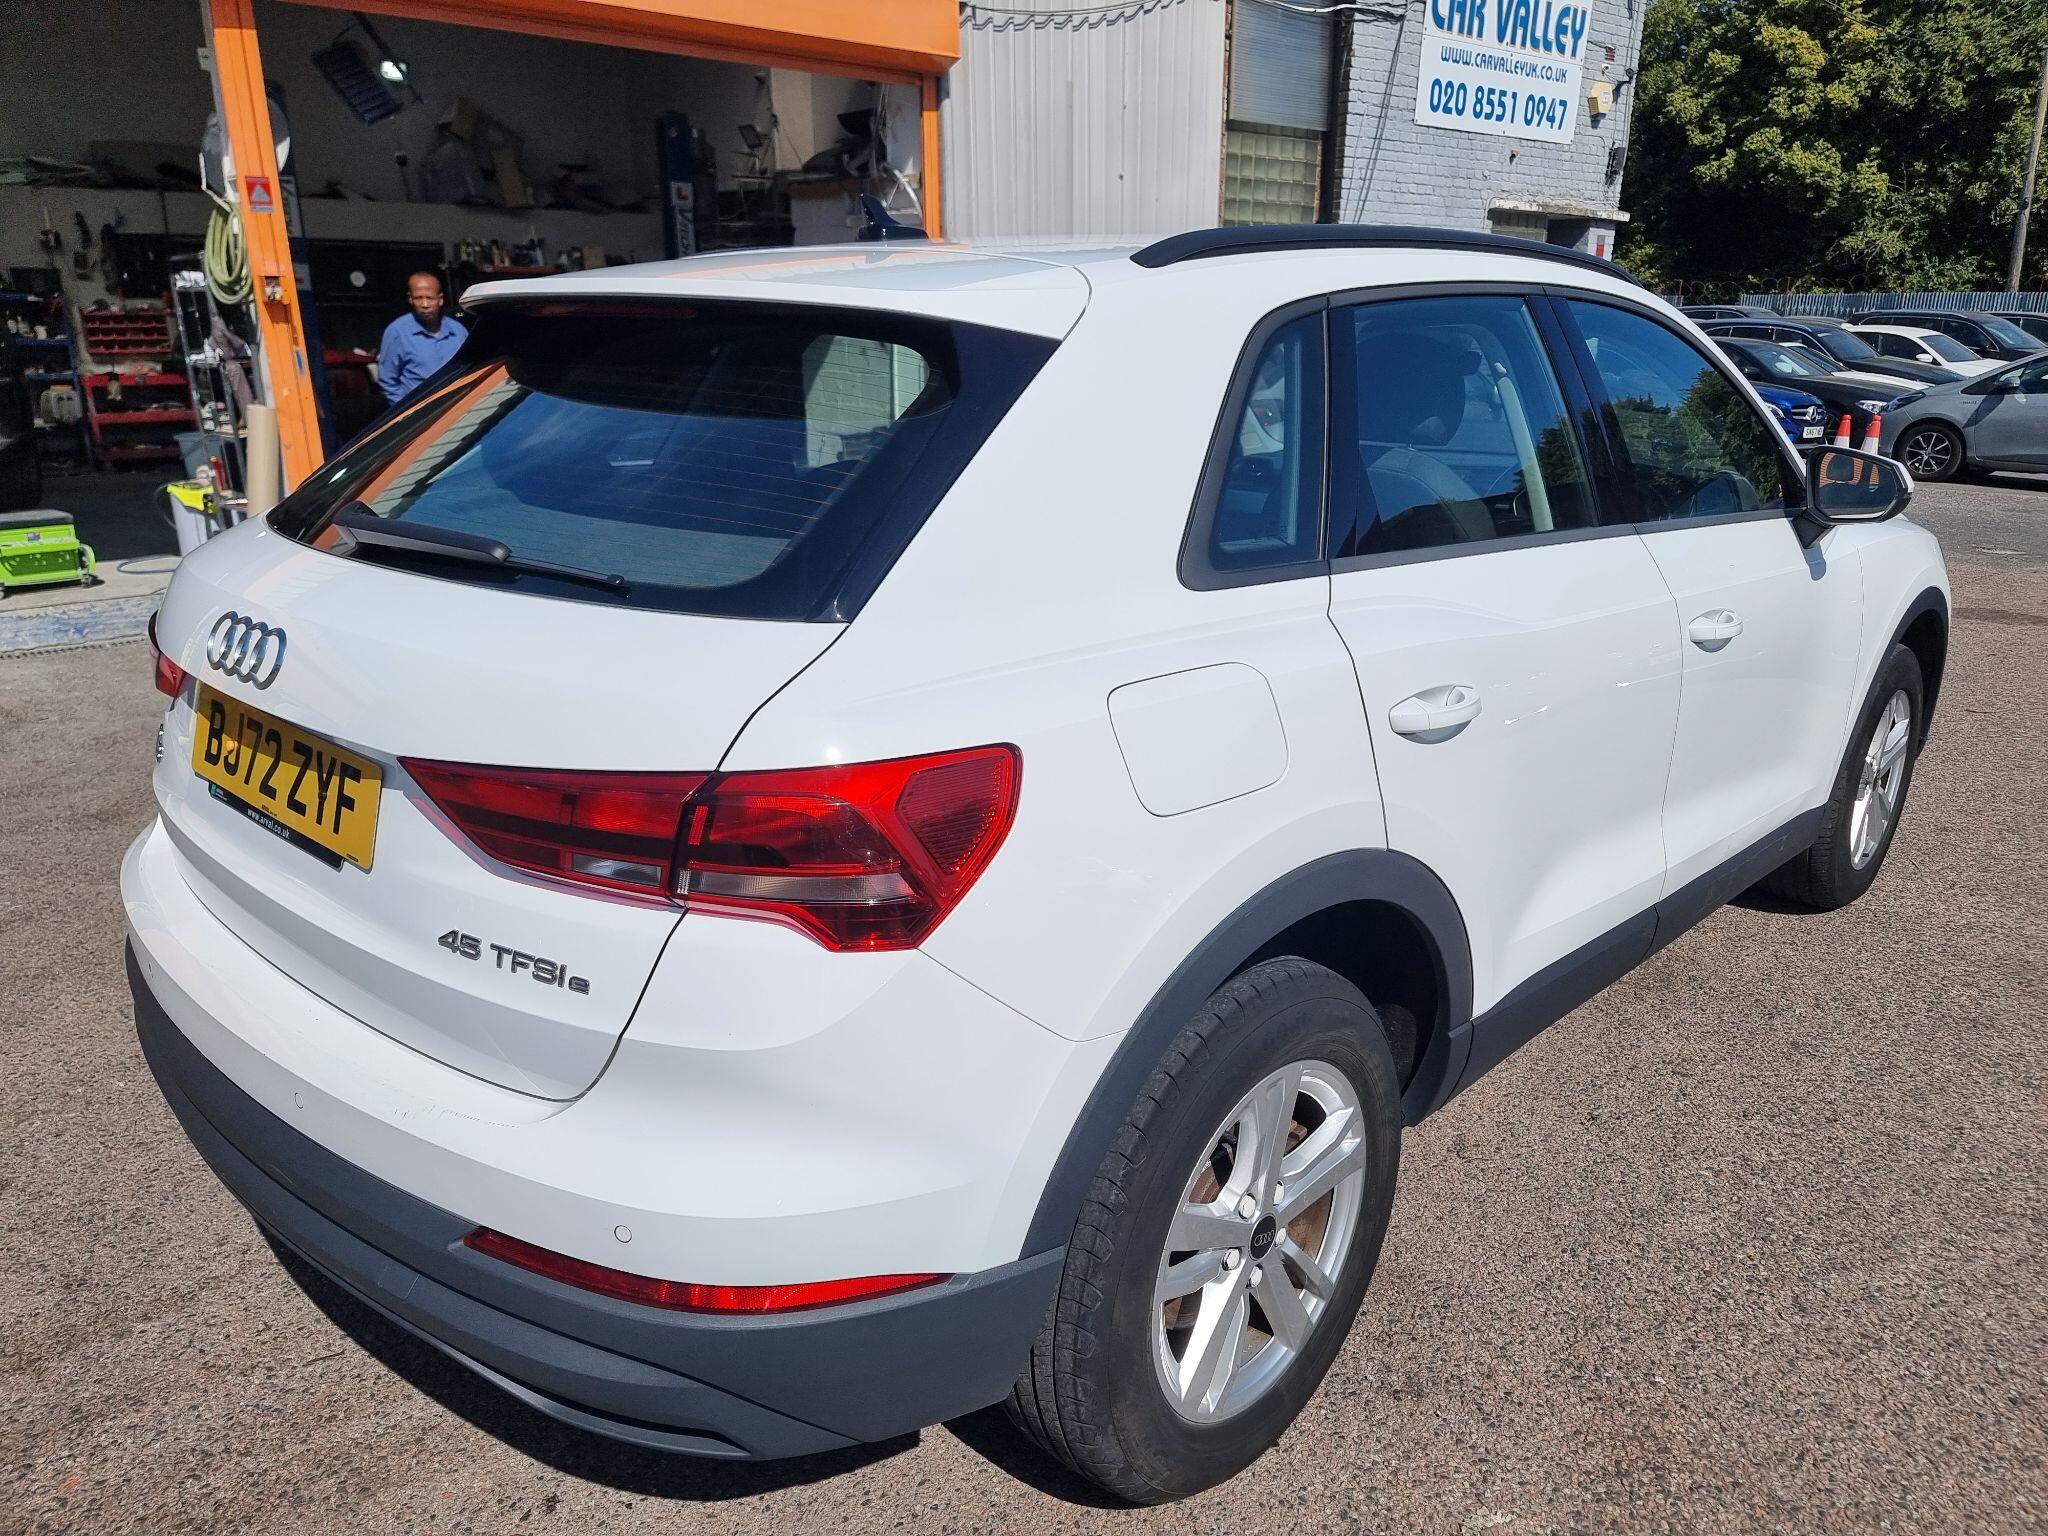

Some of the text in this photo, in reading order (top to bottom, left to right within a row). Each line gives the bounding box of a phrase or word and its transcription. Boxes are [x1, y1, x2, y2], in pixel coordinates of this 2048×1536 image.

[1432, 0, 1588, 59] CAR VALLEY
[1440, 45, 1568, 84] WWW.CARVALLEYUK.CO.UK
[1429, 78, 1568, 131] 020 8551 0947
[204, 699, 282, 801] BJ72
[286, 739, 362, 835] ZYF
[247, 808, 290, 839] www.arval.co.uk
[437, 929, 482, 960] 45
